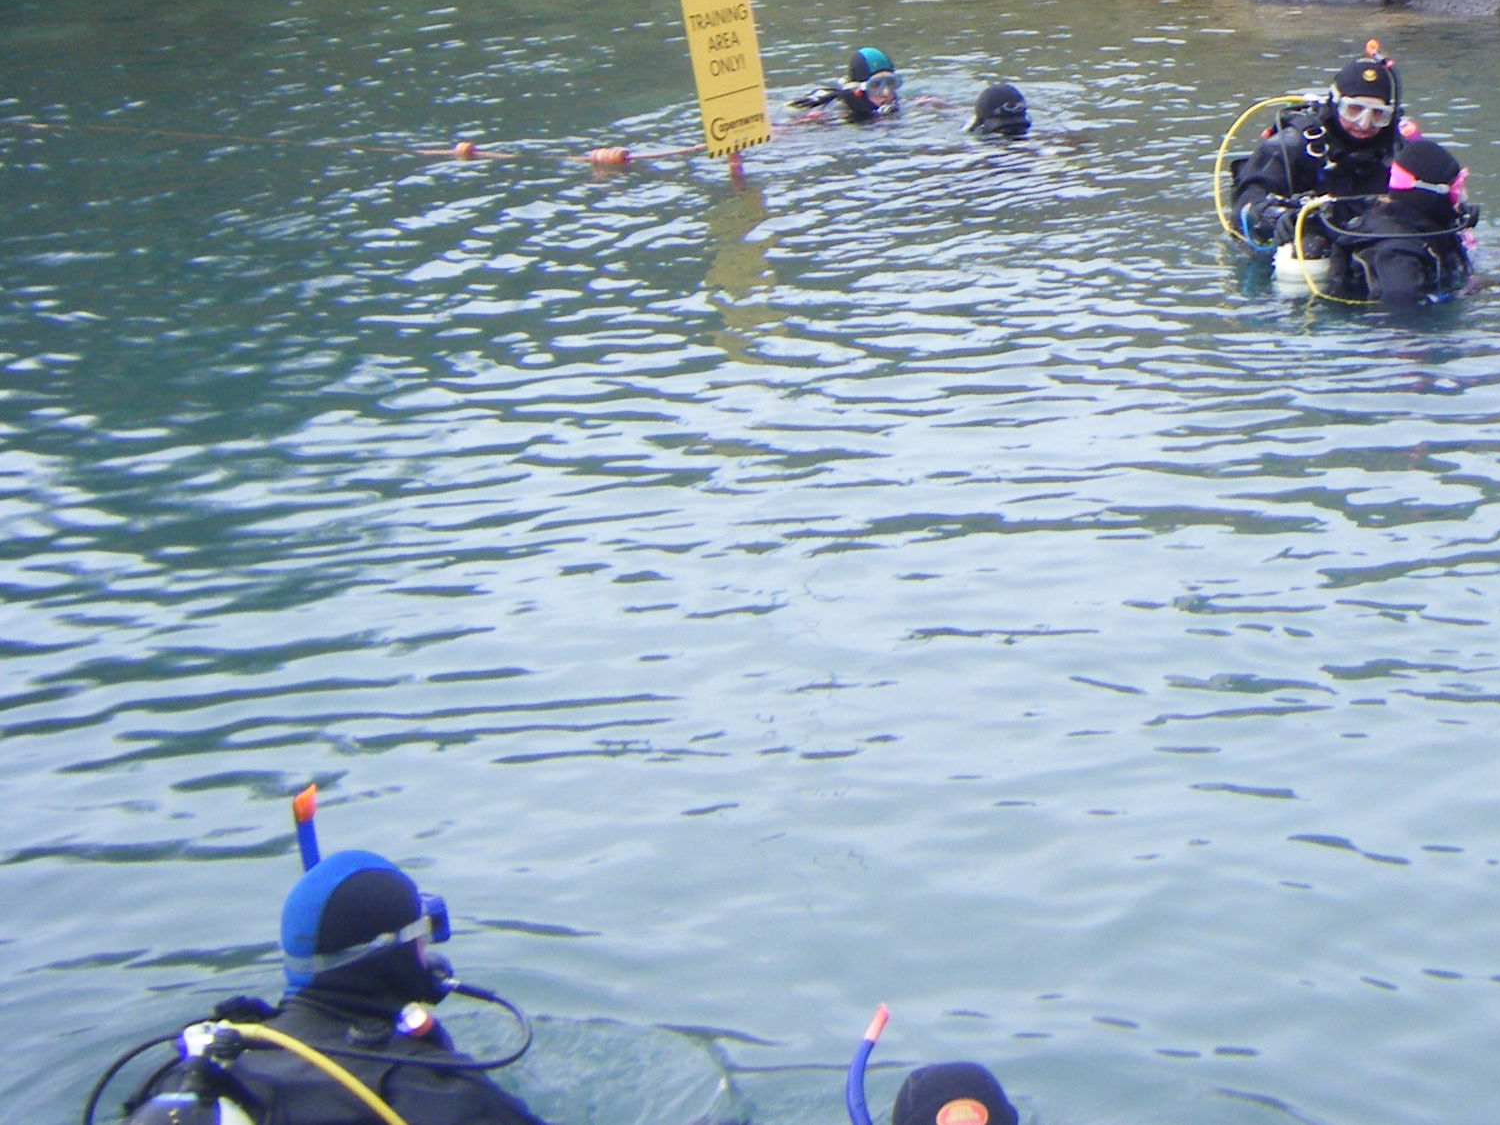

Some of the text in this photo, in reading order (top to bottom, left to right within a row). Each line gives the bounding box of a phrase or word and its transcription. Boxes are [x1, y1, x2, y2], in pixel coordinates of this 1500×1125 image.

[688, 3, 748, 32] TRAINING
[708, 31, 740, 53] AREA
[710, 53, 746, 77] ONLY!
